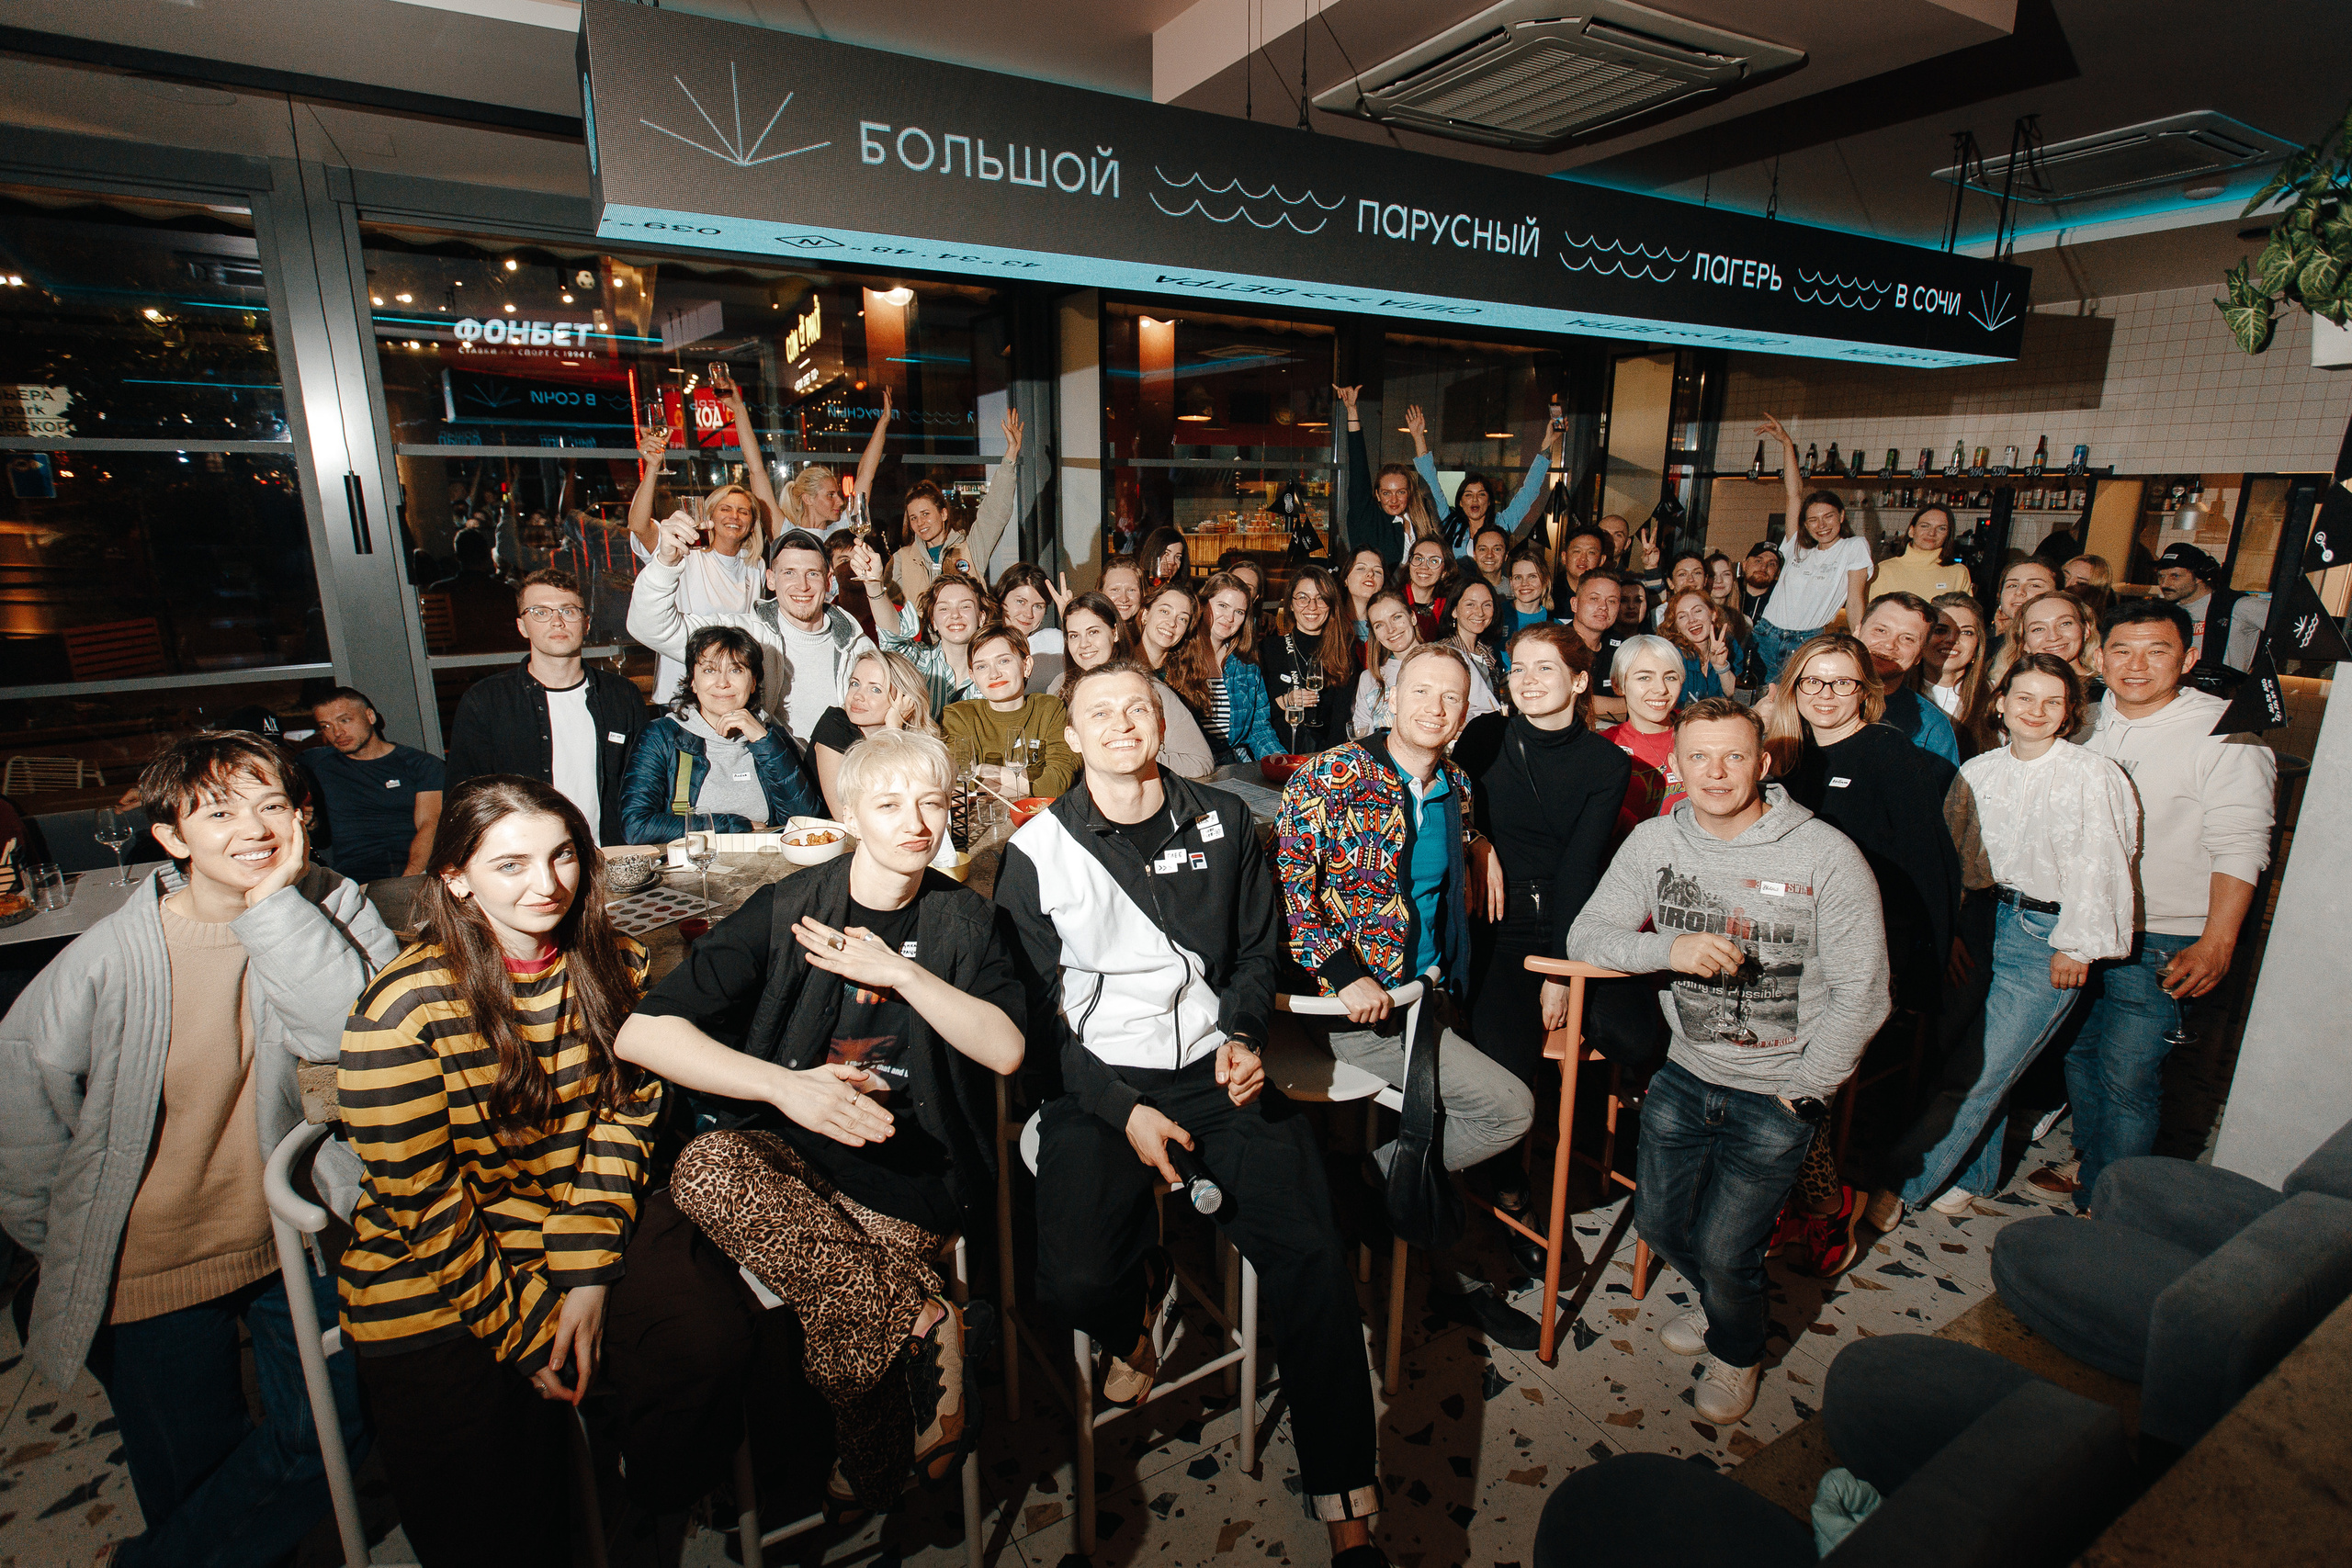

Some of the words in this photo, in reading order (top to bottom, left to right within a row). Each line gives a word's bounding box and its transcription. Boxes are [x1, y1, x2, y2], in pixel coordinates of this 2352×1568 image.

[859, 119, 1121, 198] БОЛЬШОЙ
[1894, 283, 1907, 307] В
[1913, 285, 1961, 316] СОЧИ
[1155, 275, 1298, 296] ВЕТРА
[453, 317, 594, 347] ФОНБЕТ
[517, 348, 550, 357] СПОРТ
[562, 349, 585, 358] 1994
[0, 389, 55, 401] ЬЕРА
[695, 406, 724, 430] ХОД
[1944, 467, 1959, 476] 300
[1969, 467, 1984, 477] 390
[1992, 467, 2007, 477] 390
[2066, 464, 2084, 476] 390
[876, 1064, 891, 1073] that
[891, 1067, 905, 1077] and
